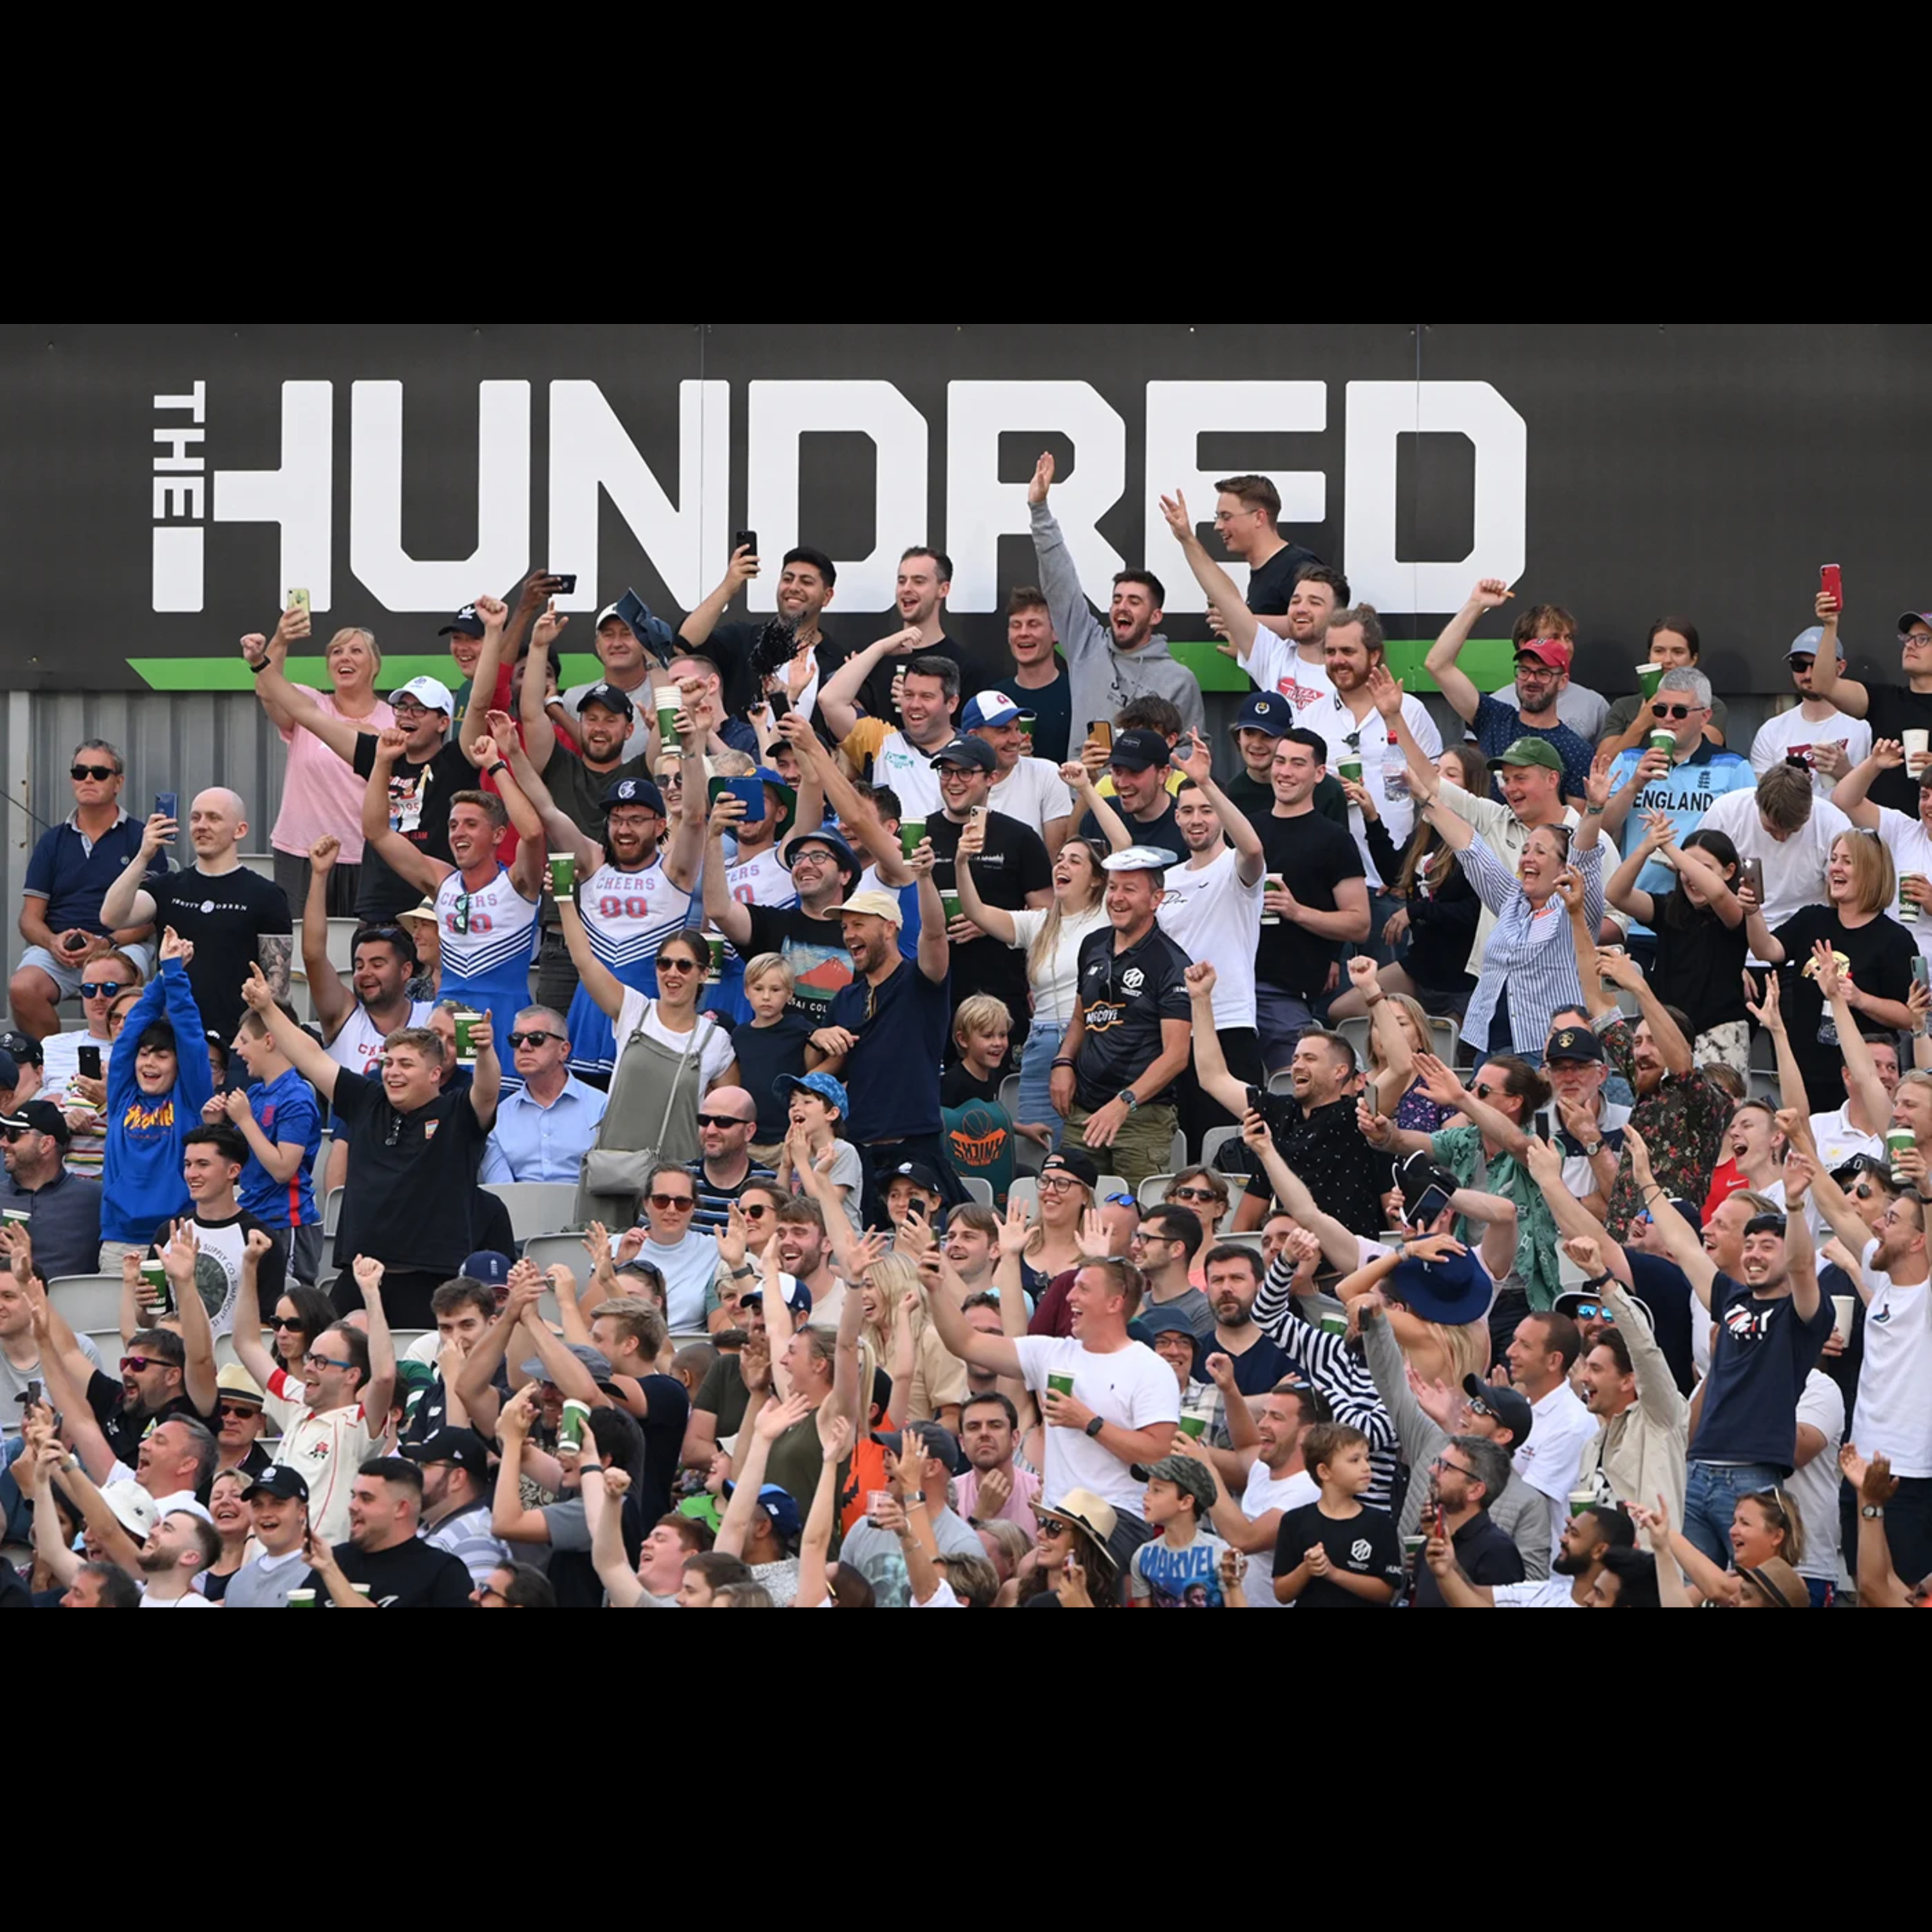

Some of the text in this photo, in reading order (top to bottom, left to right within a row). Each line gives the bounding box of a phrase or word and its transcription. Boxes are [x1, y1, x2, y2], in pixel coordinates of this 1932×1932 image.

[153, 381, 205, 518] THE
[214, 381, 1527, 613] HUNDRED
[1633, 790, 1714, 813] ENGLAND
[597, 876, 655, 891] CHEERS
[727, 864, 760, 882] ERS
[440, 892, 497, 909] CHERS
[733, 884, 755, 904] 0
[600, 896, 647, 918] 00
[204, 1244, 227, 1262] SUPPLY
[225, 1262, 236, 1278] CO.
[1139, 1546, 1215, 1578] MARVEL
